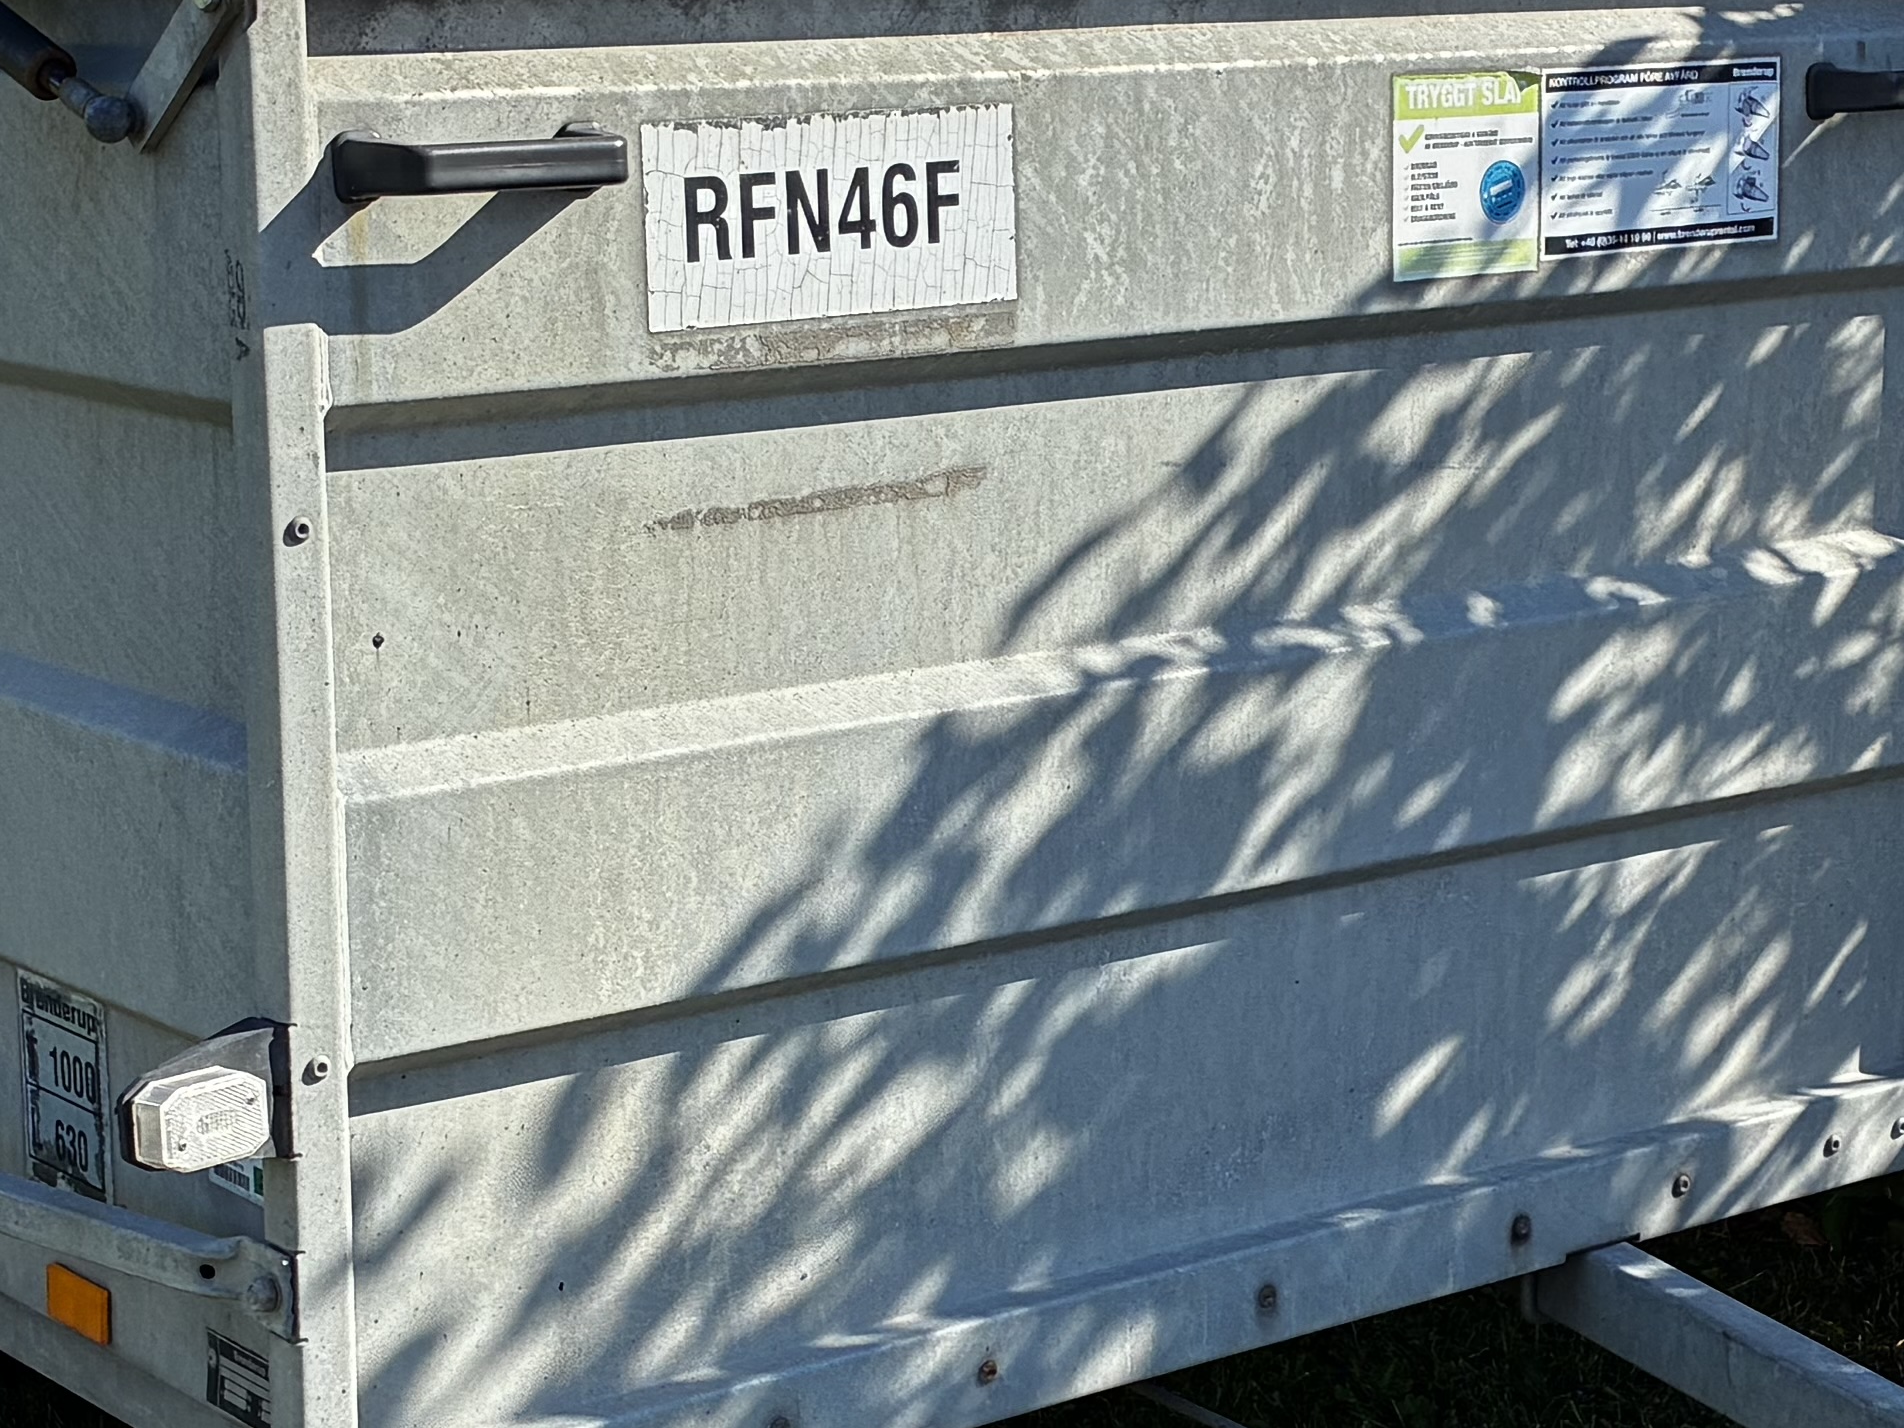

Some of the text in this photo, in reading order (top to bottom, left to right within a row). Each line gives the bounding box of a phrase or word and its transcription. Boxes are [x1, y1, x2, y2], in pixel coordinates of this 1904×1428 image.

[1405, 81, 1477, 110] TRYGGT
[1548, 71, 1639, 89] KONTROLLPROGRAM
[683, 159, 961, 264] RFN46F
[19, 976, 96, 1036] Brenderup
[49, 1045, 96, 1106] 1000
[55, 1119, 89, 1173] 630
